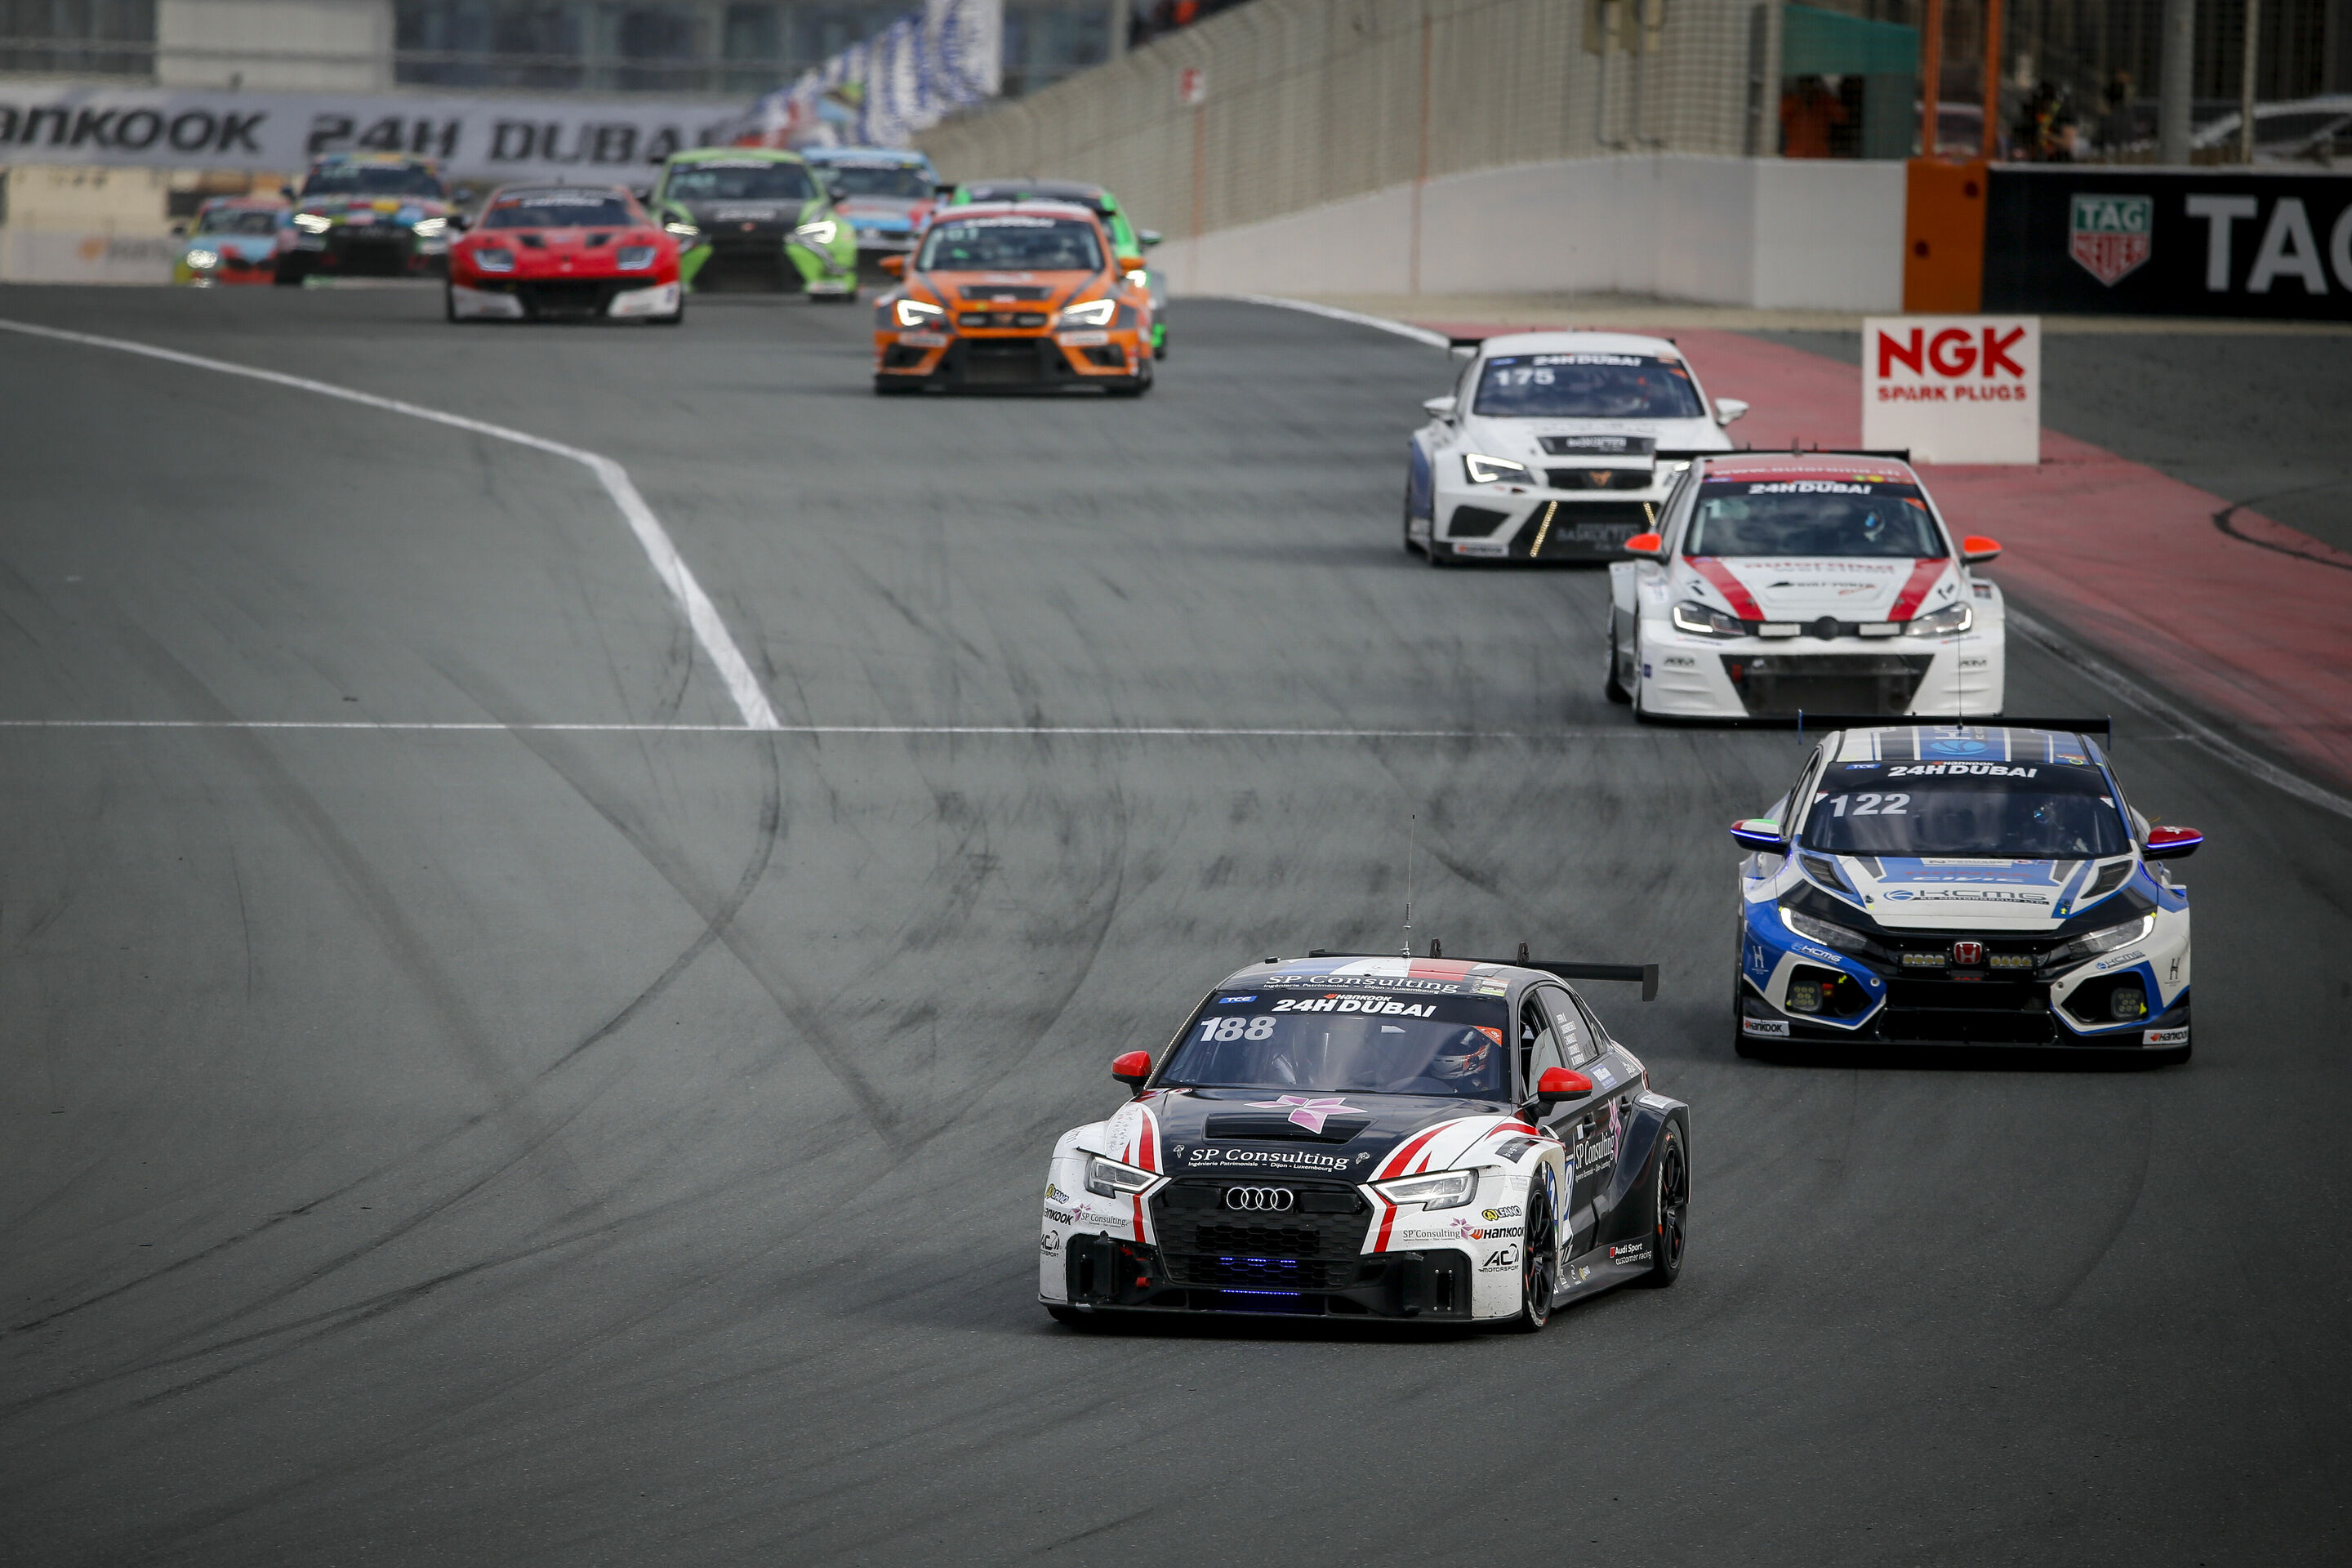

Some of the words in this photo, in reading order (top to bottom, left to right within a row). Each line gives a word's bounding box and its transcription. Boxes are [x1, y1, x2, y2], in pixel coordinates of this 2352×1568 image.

[307, 113, 461, 158] 24H
[2082, 203, 2145, 229] TAG
[1878, 326, 2026, 379] NGK
[1494, 368, 1555, 386] 175
[1878, 385, 1947, 401] SPARK
[1953, 384, 2027, 401] PLUGS
[1949, 764, 2038, 778] DUBAI
[1829, 792, 1911, 817] 122
[1920, 889, 2047, 902] KCMG
[1802, 944, 1842, 963] KCMG
[2105, 950, 2144, 966] KCMG
[1265, 975, 1302, 985] SP
[1309, 975, 1462, 994] Consulting
[1392, 986, 1440, 996] Luxembourg
[1337, 1000, 1437, 1018] DUBAI
[1200, 1016, 1276, 1042] 188
[1190, 1148, 1220, 1161] SP
[1225, 1148, 1350, 1170] Consulting
[1575, 1143, 1585, 1170] SP
[1584, 1132, 1615, 1166] Consulting
[1293, 1164, 1333, 1173] Luxembourg
[1081, 1212, 1090, 1222] SP
[1091, 1213, 1126, 1228] Consulting
[1481, 1205, 1522, 1222] ALFANO
[1415, 1228, 1461, 1240] Consulting
[1615, 1246, 1628, 1255] Audi
[1628, 1242, 1643, 1254] Sport
[1615, 1254, 1638, 1266] customer
[1638, 1250, 1652, 1260] racing
[1479, 1265, 1519, 1273] MOTORSPORT
